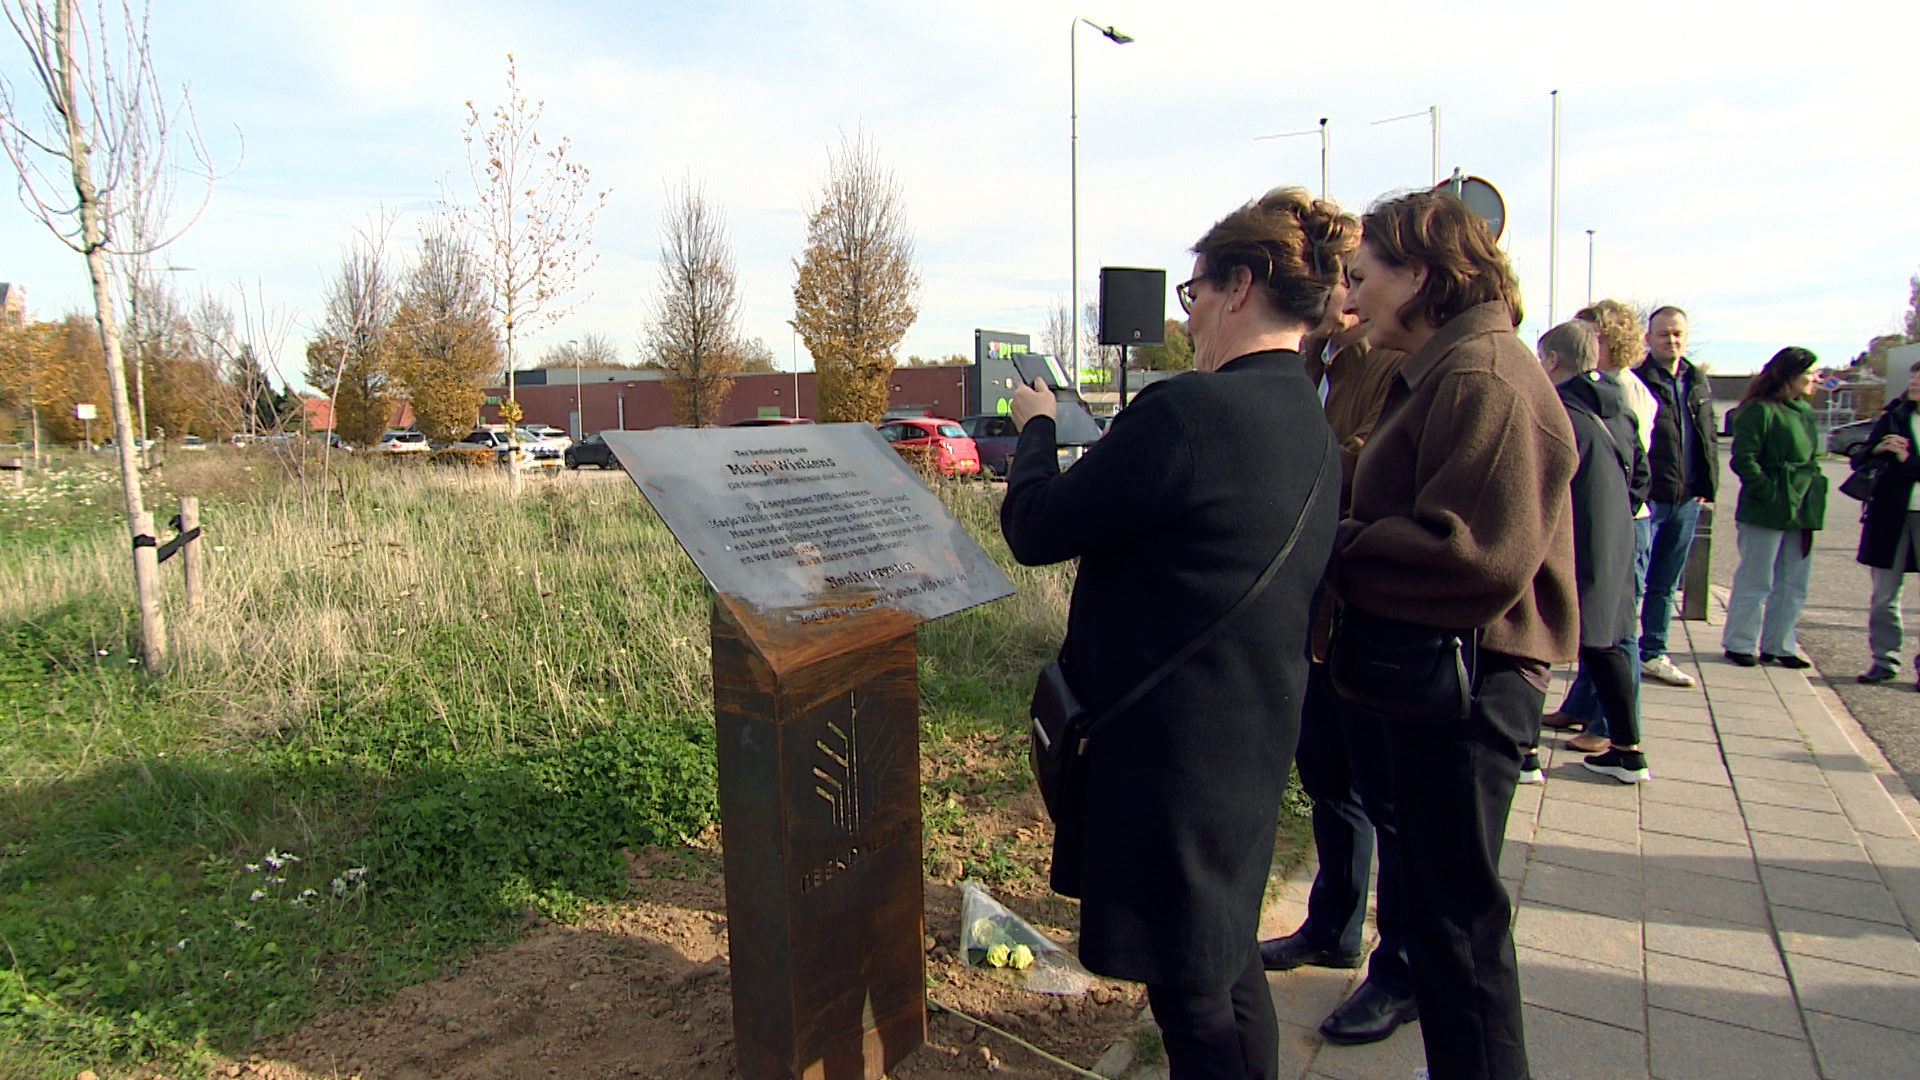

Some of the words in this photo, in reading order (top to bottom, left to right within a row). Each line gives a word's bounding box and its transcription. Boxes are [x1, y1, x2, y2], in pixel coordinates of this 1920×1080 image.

[726, 460, 772, 476] Marjo
[773, 458, 835, 471] Winkens
[708, 516, 738, 529] Marjo
[730, 528, 754, 539] Haar
[825, 571, 863, 588] Nooit
[863, 562, 914, 580] vergeten
